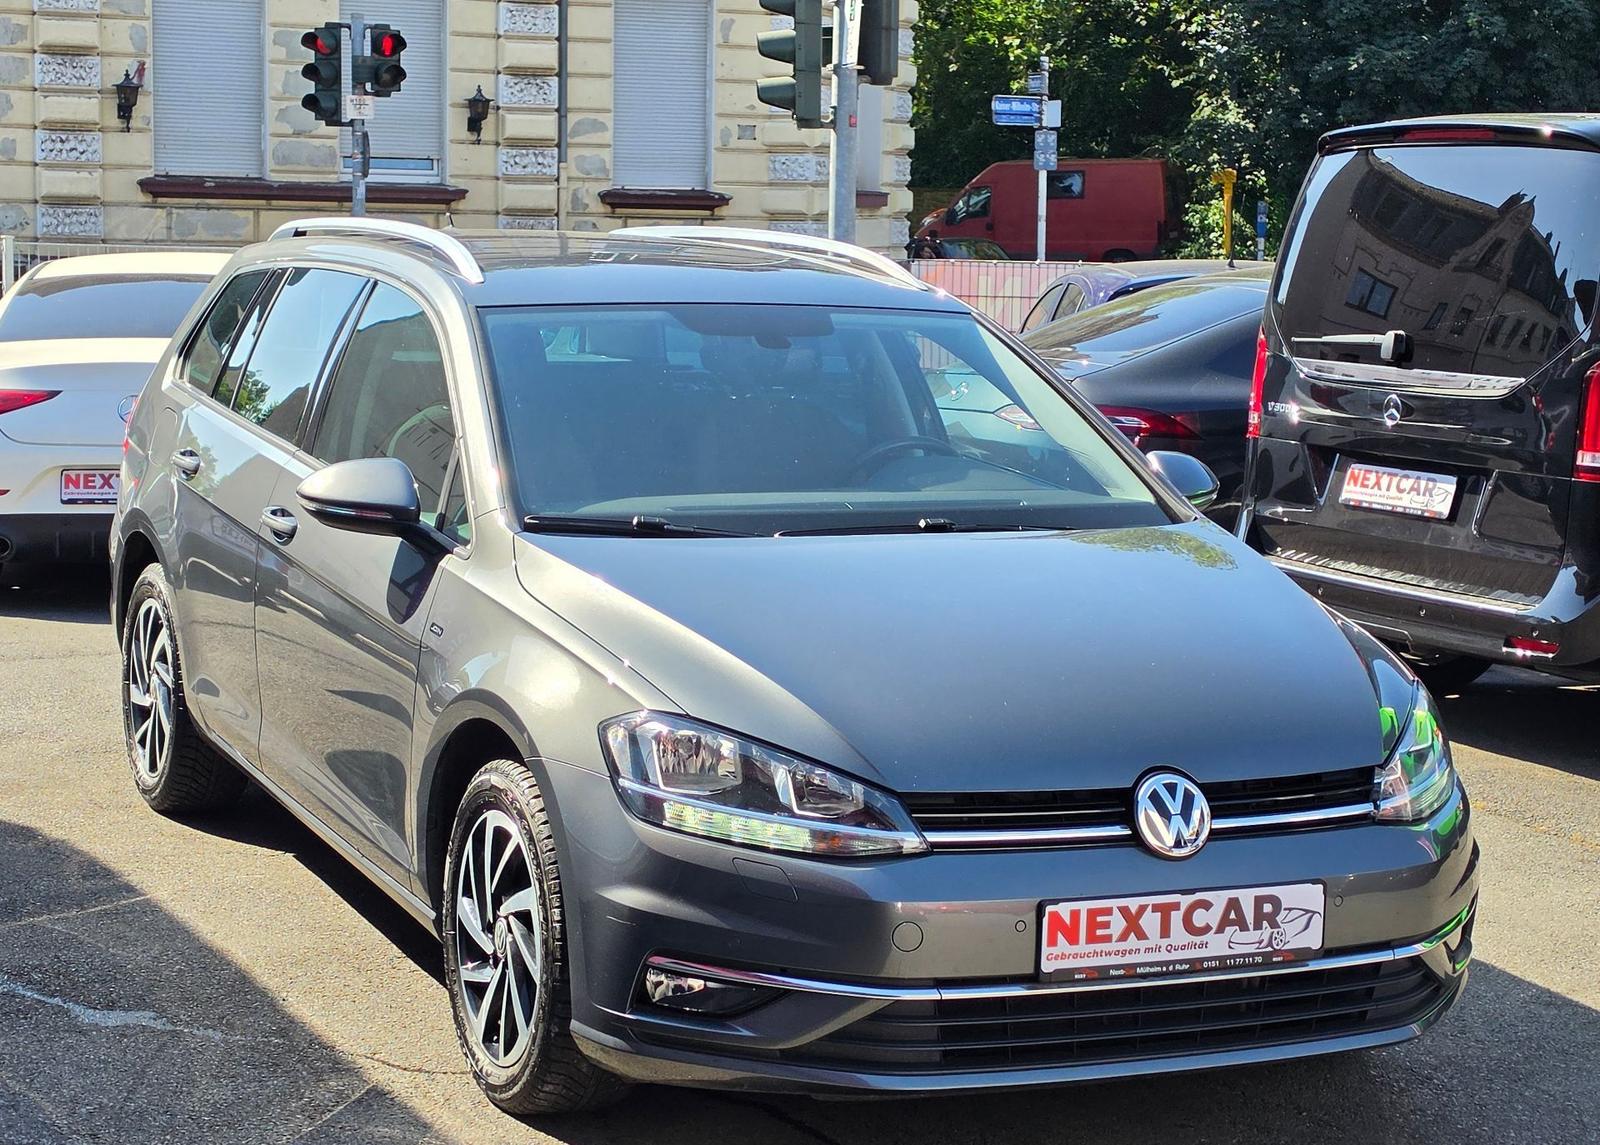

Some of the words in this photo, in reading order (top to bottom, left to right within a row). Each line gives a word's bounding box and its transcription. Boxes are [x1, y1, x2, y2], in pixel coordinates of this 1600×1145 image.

[1347, 467, 1438, 498] NEXTCAR
[1046, 894, 1282, 948] NEXTCAR
[1046, 947, 1141, 962] Gebrauchtwagen
[1143, 943, 1162, 954] mit
[1165, 940, 1209, 954] Qualität
[1203, 960, 1220, 968] 0151
